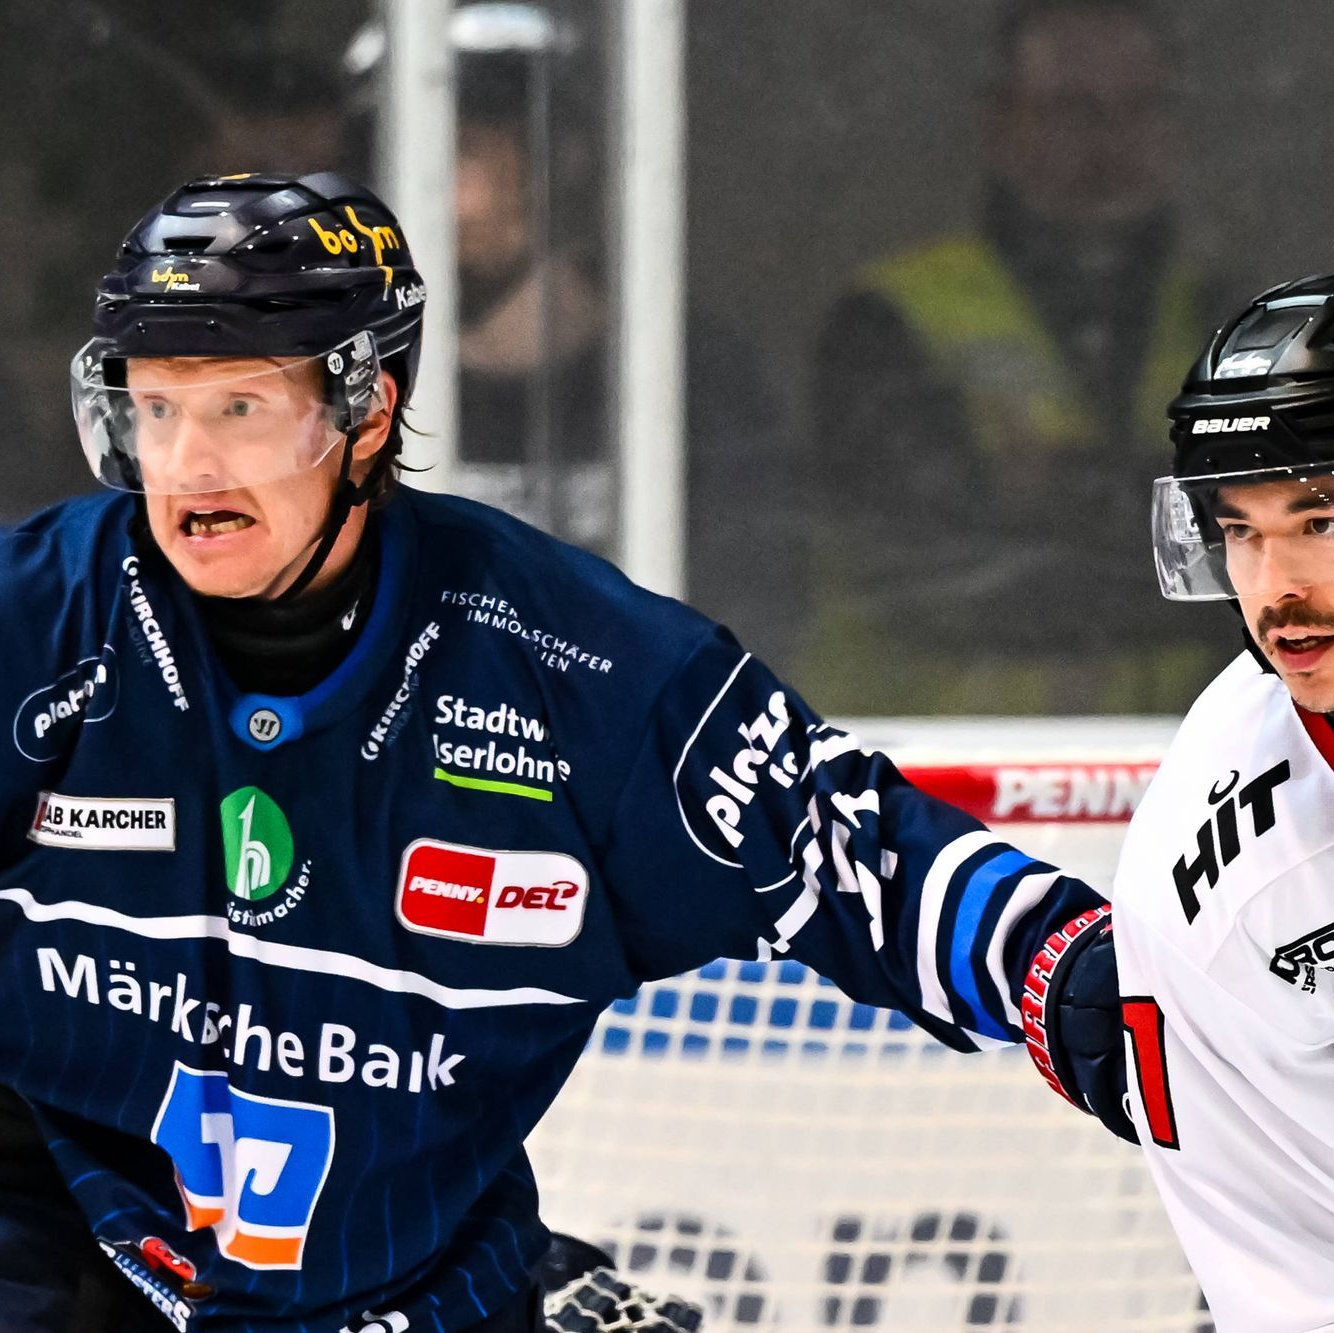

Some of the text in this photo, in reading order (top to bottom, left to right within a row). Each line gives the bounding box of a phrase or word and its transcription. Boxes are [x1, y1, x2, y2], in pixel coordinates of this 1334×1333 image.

[1192, 415, 1271, 435] BAUER
[130, 579, 191, 712] KIRCHHOFF
[434, 694, 551, 742] Stadtw
[993, 768, 1158, 818] PENN
[69, 808, 167, 830] KARCHER
[1171, 758, 1292, 925] HIT
